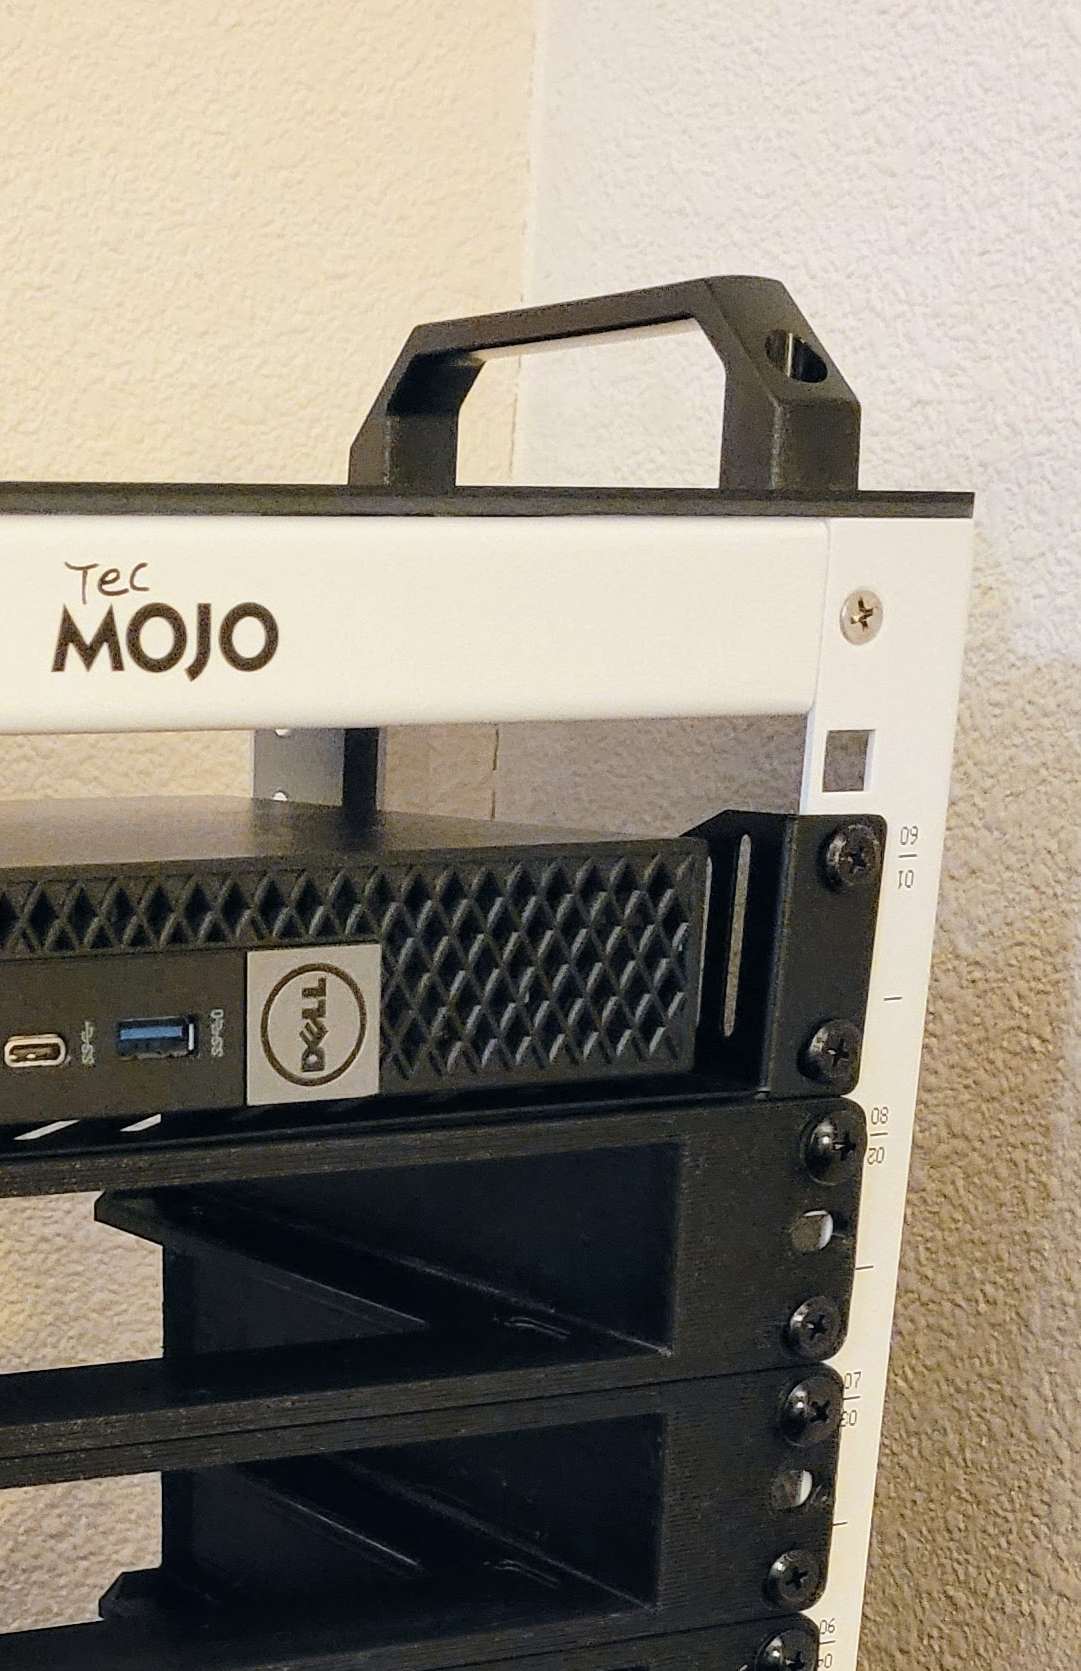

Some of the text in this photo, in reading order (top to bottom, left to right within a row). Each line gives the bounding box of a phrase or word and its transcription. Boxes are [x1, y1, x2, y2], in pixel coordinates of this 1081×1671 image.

[64, 561, 150, 605] Tec
[50, 601, 280, 682] MOJO
[299, 975, 330, 1073] DELL
